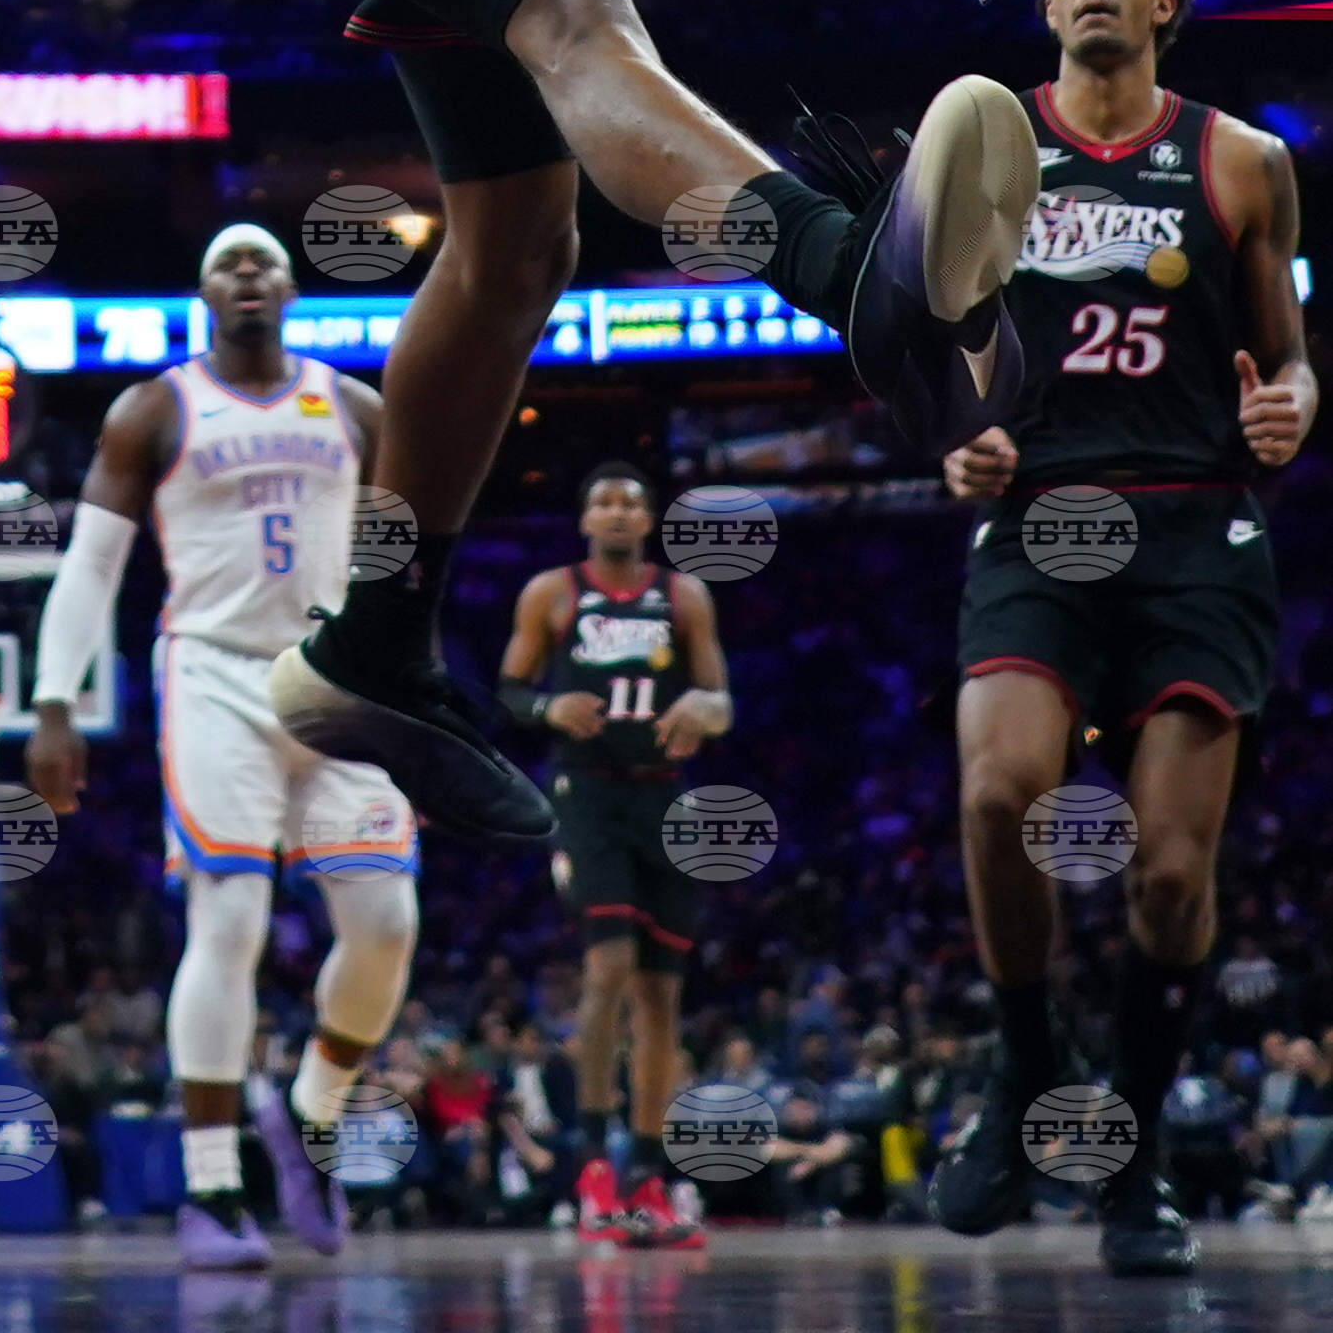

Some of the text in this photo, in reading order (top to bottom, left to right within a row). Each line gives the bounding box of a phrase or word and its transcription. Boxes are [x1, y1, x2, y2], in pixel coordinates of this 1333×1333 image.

[1061, 302, 1169, 377] 25
[192, 432, 345, 480] OKLAHOMA
[261, 511, 296, 576] 5
[606, 676, 656, 720] 11
